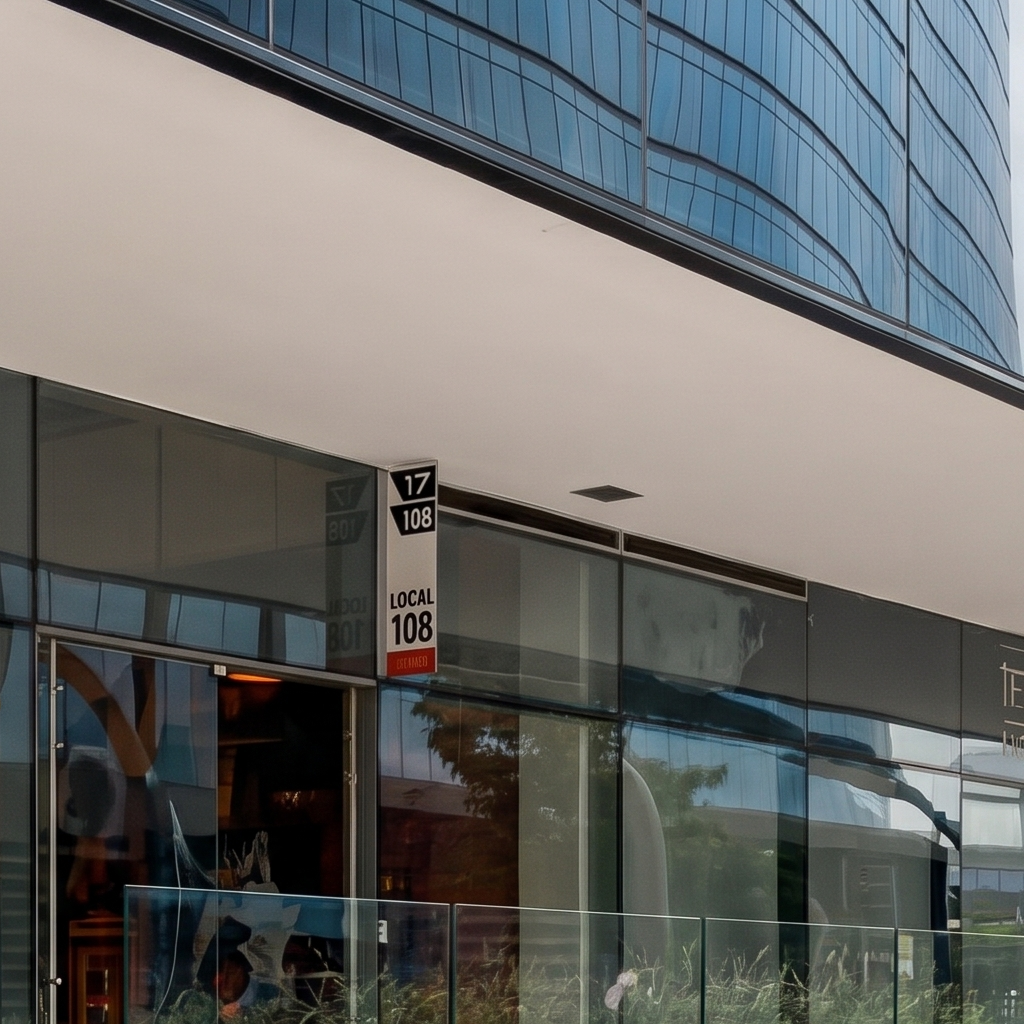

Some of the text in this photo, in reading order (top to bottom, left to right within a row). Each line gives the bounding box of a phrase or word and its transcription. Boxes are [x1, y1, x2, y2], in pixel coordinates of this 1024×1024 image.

[404, 471, 431, 496] 17
[403, 506, 433, 531] 108
[390, 588, 435, 610] LOCAL
[391, 610, 433, 645] 108
